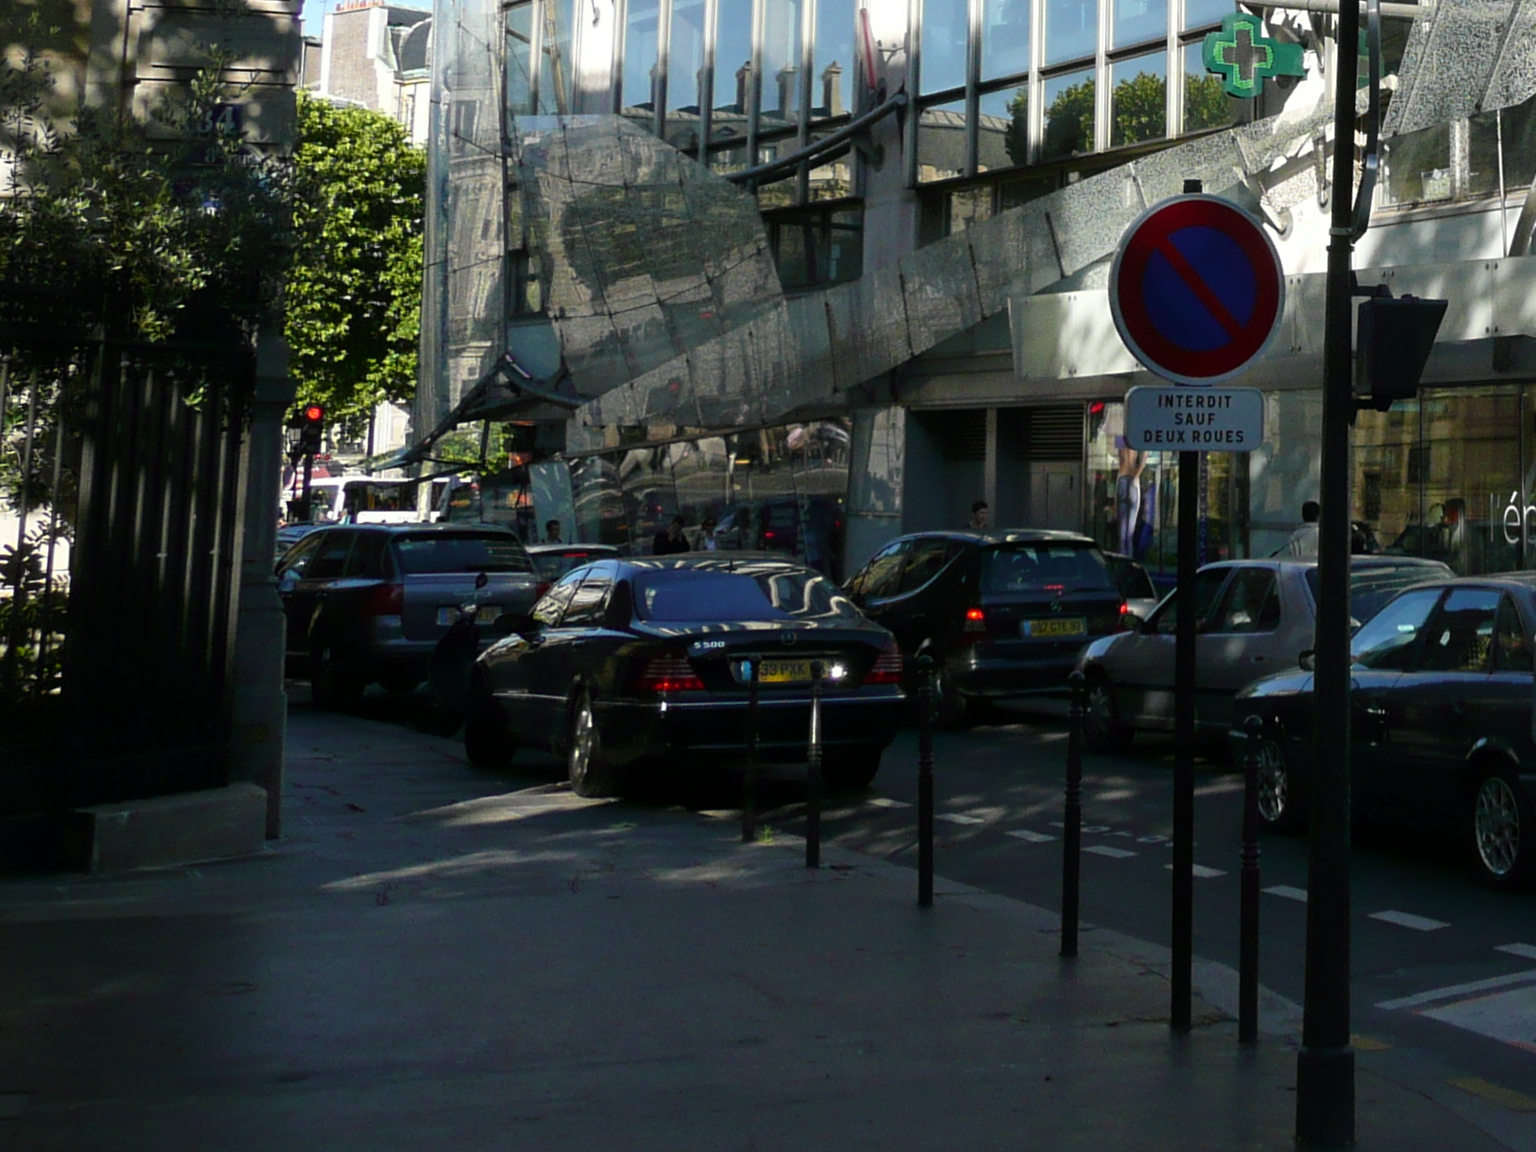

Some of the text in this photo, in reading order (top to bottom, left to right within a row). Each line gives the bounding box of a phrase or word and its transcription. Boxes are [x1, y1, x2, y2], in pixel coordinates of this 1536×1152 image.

[1157, 394, 1232, 408] INTERDIT
[1174, 412, 1216, 426] SAUF
[1143, 430, 1244, 443] DEUX ROUES
[703, 640, 726, 648] 500
